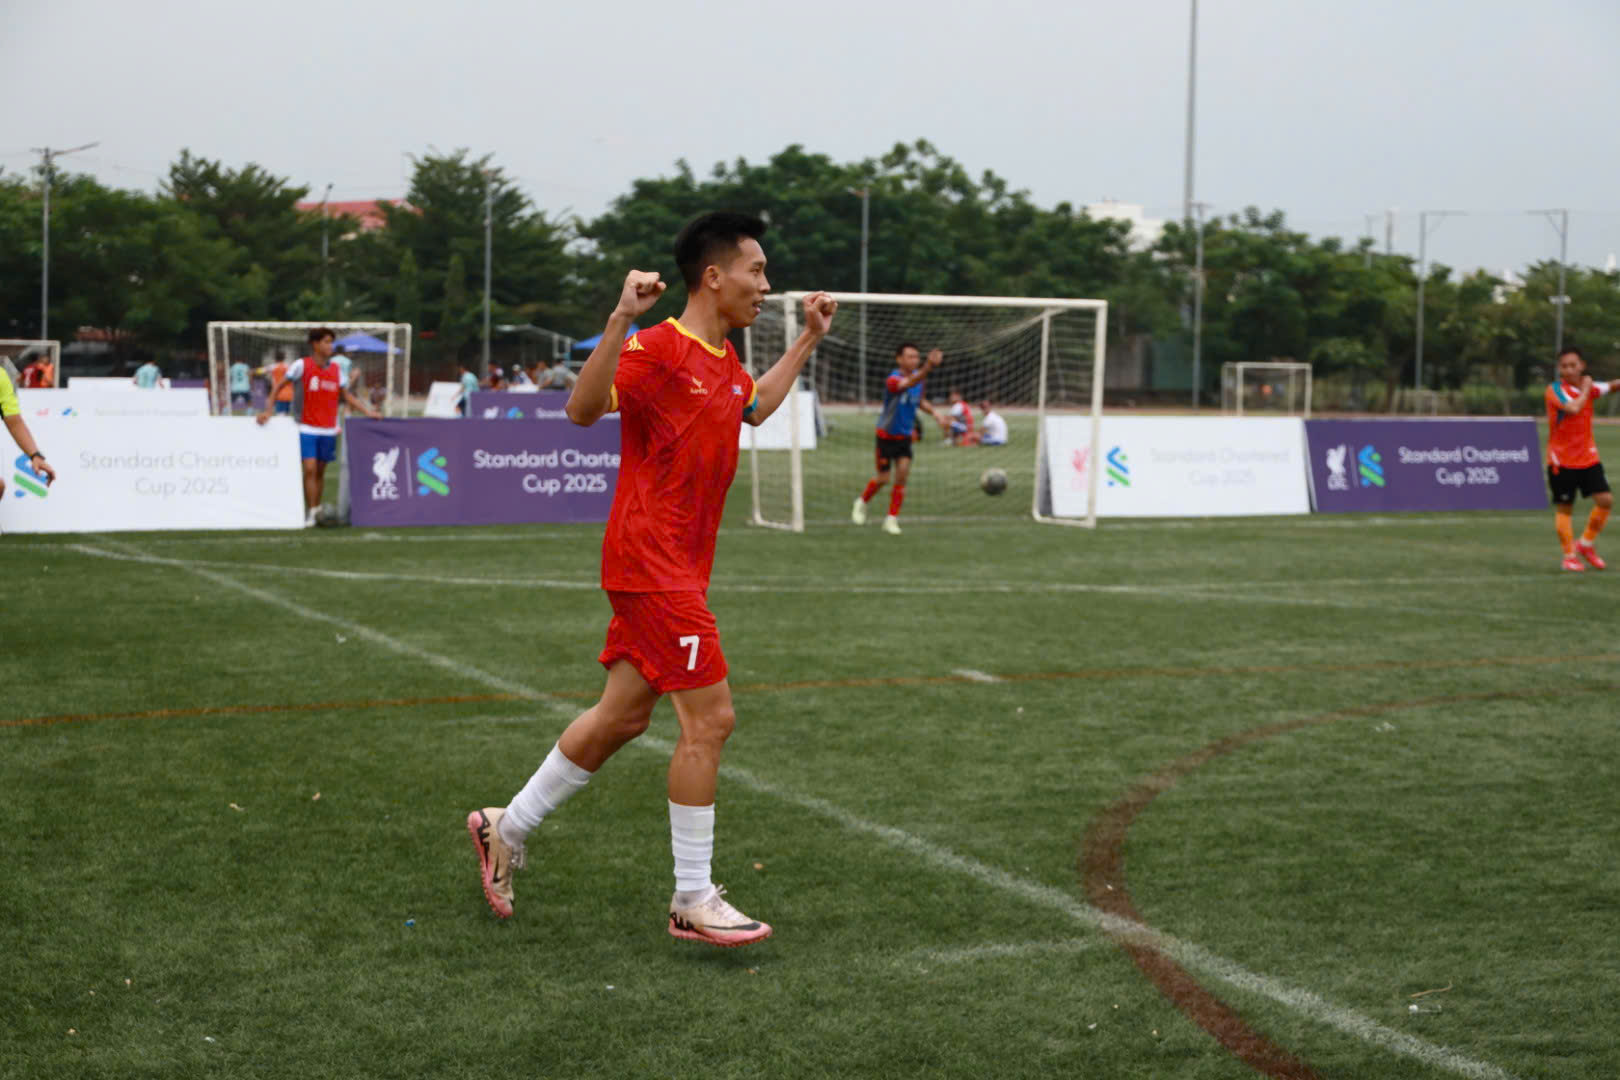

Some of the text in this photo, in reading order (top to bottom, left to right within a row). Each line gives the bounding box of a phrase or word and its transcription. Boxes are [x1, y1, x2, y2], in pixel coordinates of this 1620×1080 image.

[79, 449, 280, 470] Standard Chartered
[472, 449, 622, 469] Standard Charte
[1398, 445, 1530, 464] Standard Chartered
[522, 473, 608, 496] Cup 2025
[1435, 467, 1499, 488] Cup 2025
[135, 476, 231, 501] Cup 2025
[371, 486, 400, 500] LFC
[679, 634, 700, 671] 7
